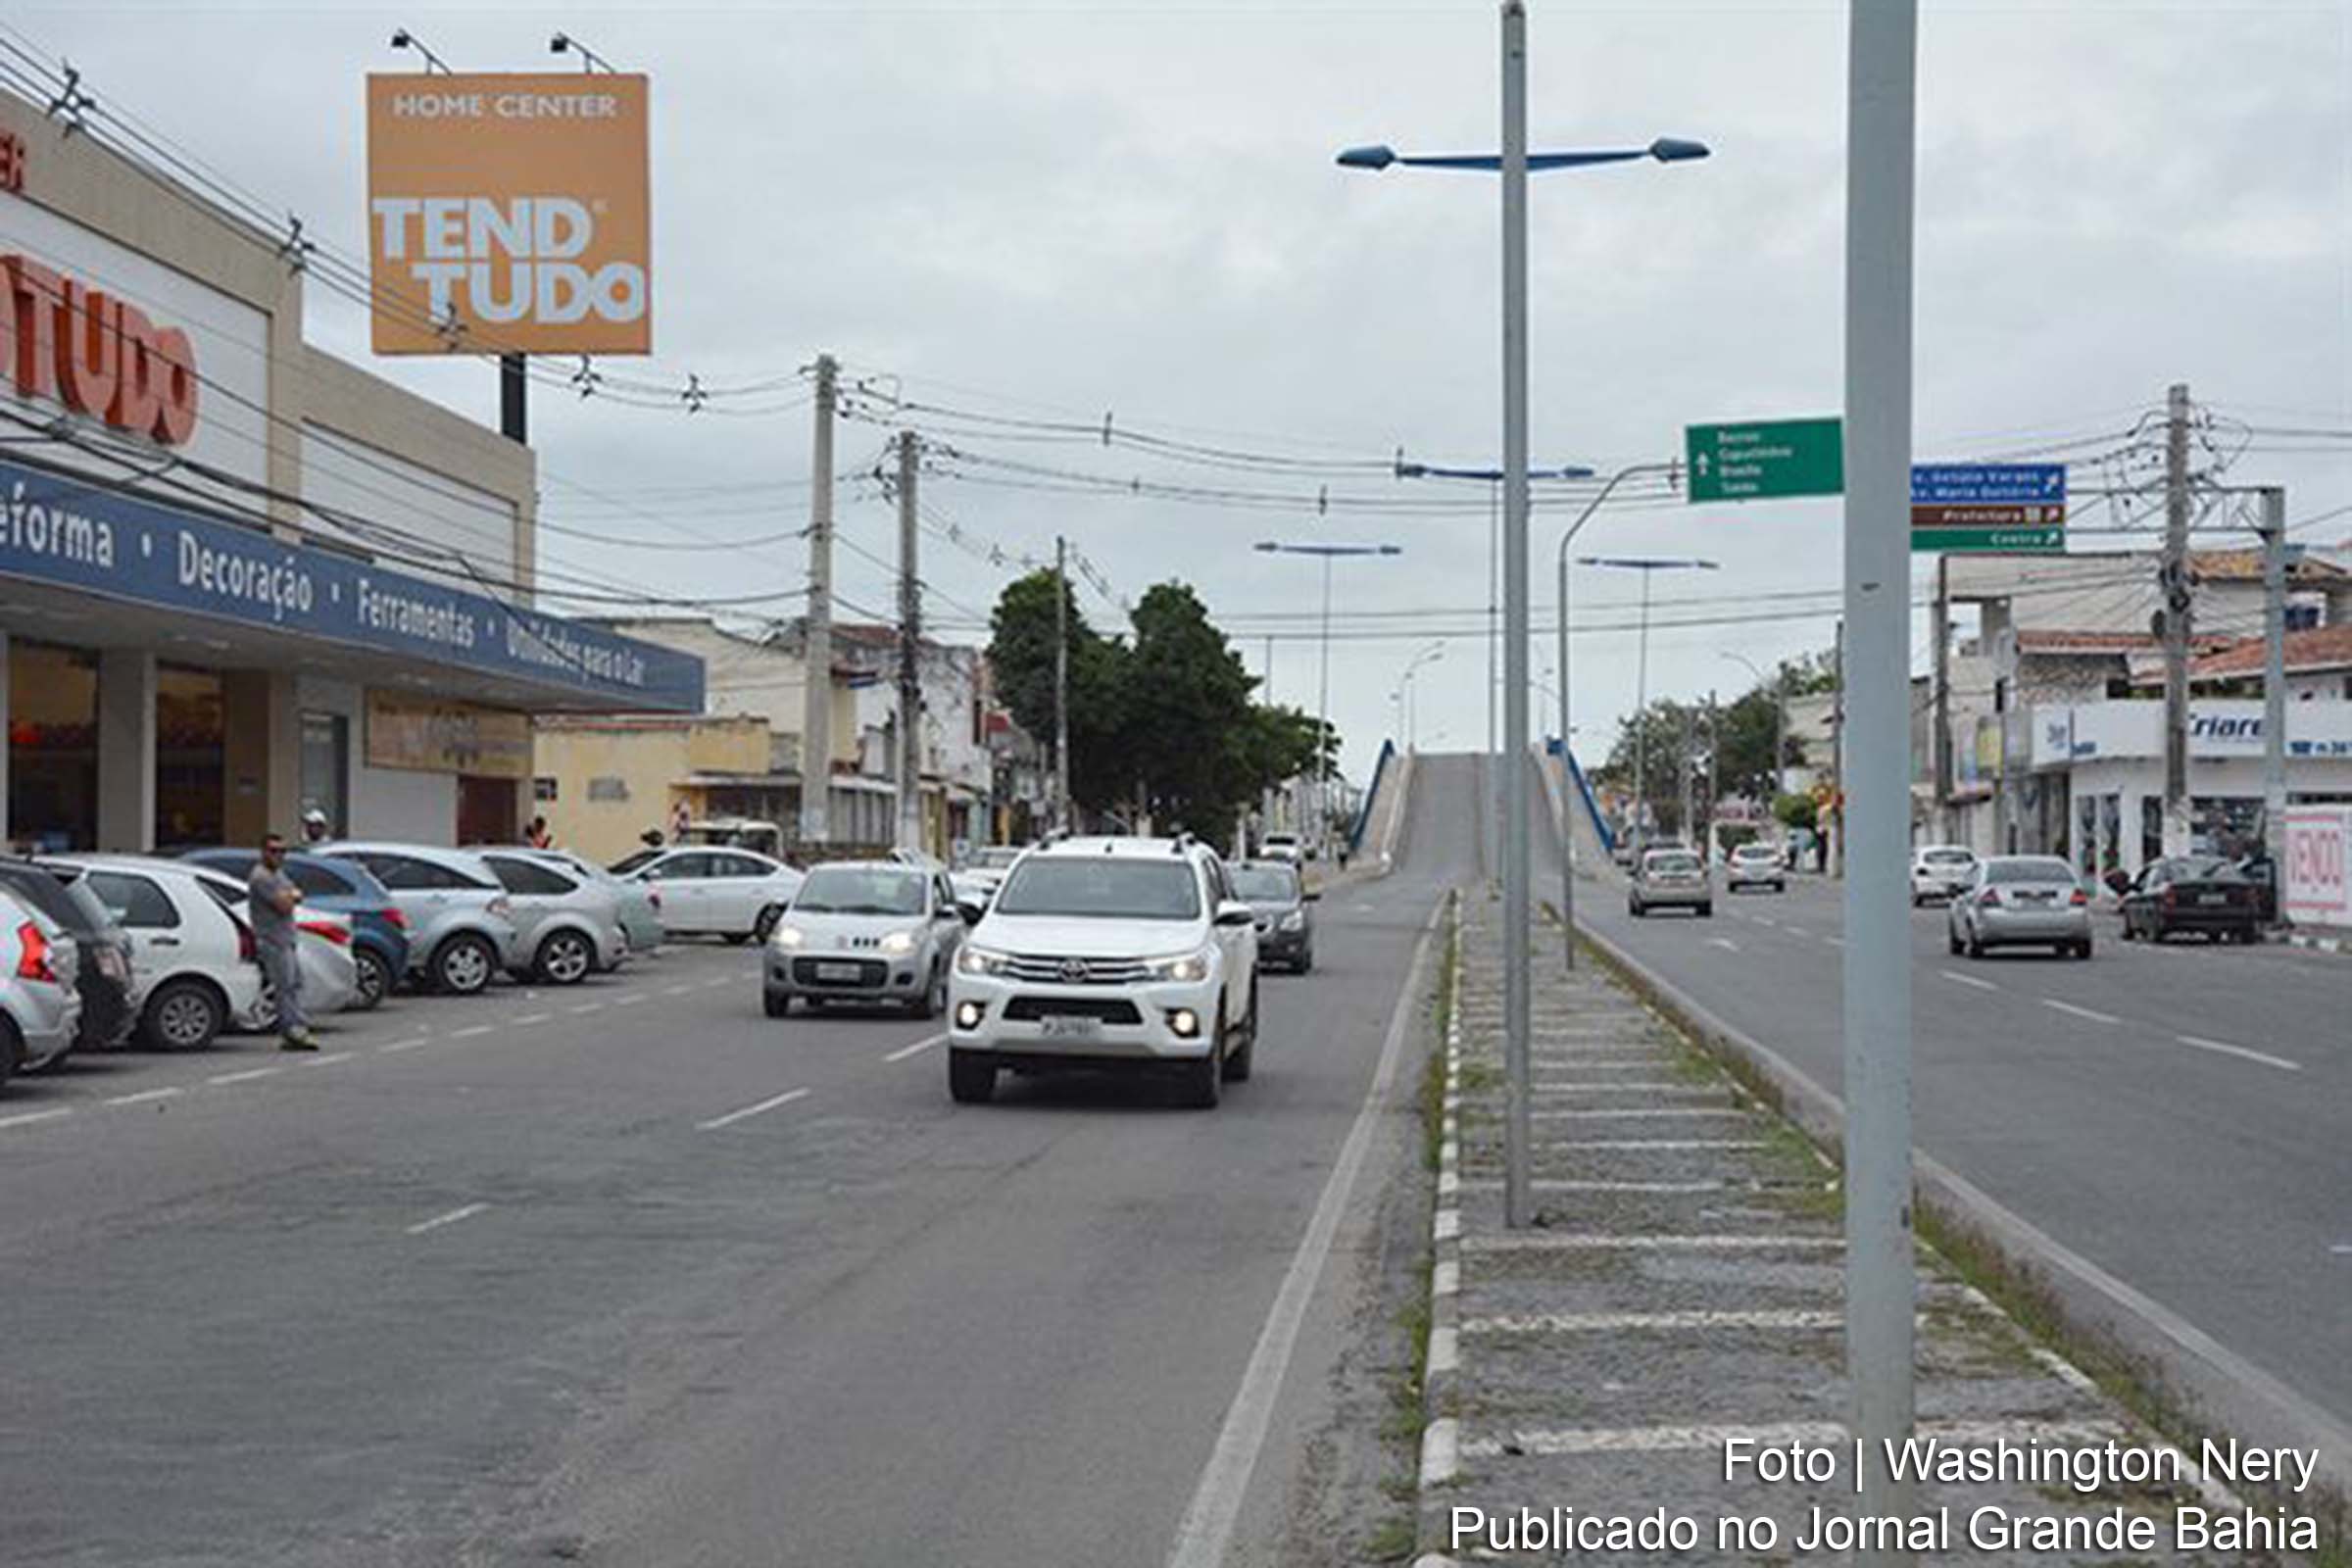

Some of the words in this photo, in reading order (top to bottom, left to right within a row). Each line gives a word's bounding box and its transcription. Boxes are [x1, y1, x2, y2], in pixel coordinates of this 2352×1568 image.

[393, 95, 481, 119] HOME
[495, 94, 618, 119] CENTER
[371, 198, 593, 259] TEND
[412, 261, 645, 324] TUDO
[177, 530, 314, 621] Decoração
[357, 578, 475, 648] Ferramentas
